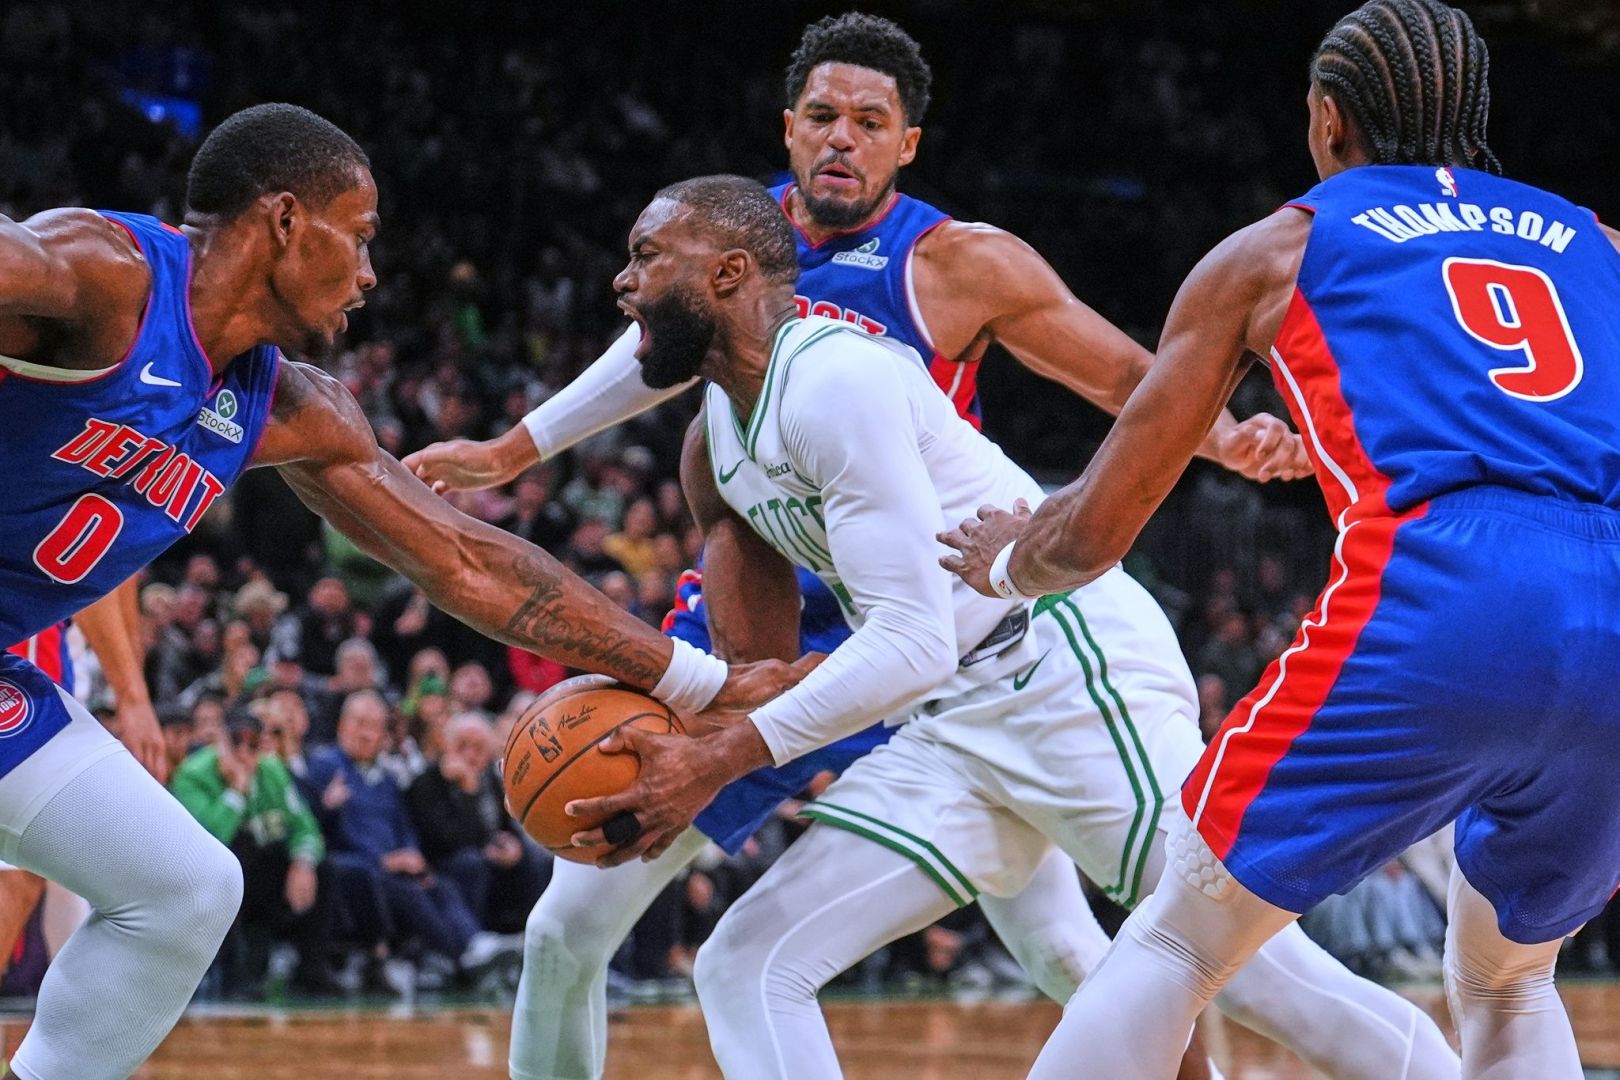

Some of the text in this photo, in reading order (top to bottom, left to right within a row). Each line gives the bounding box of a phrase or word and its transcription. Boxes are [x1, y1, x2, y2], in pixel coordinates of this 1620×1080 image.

[834, 250, 888, 268] StockX
[1351, 202, 1577, 254] THOMPSON
[1442, 256, 1584, 402] 9
[198, 408, 242, 441] StockX
[51, 417, 226, 534] DETROIT
[33, 492, 124, 584] 0
